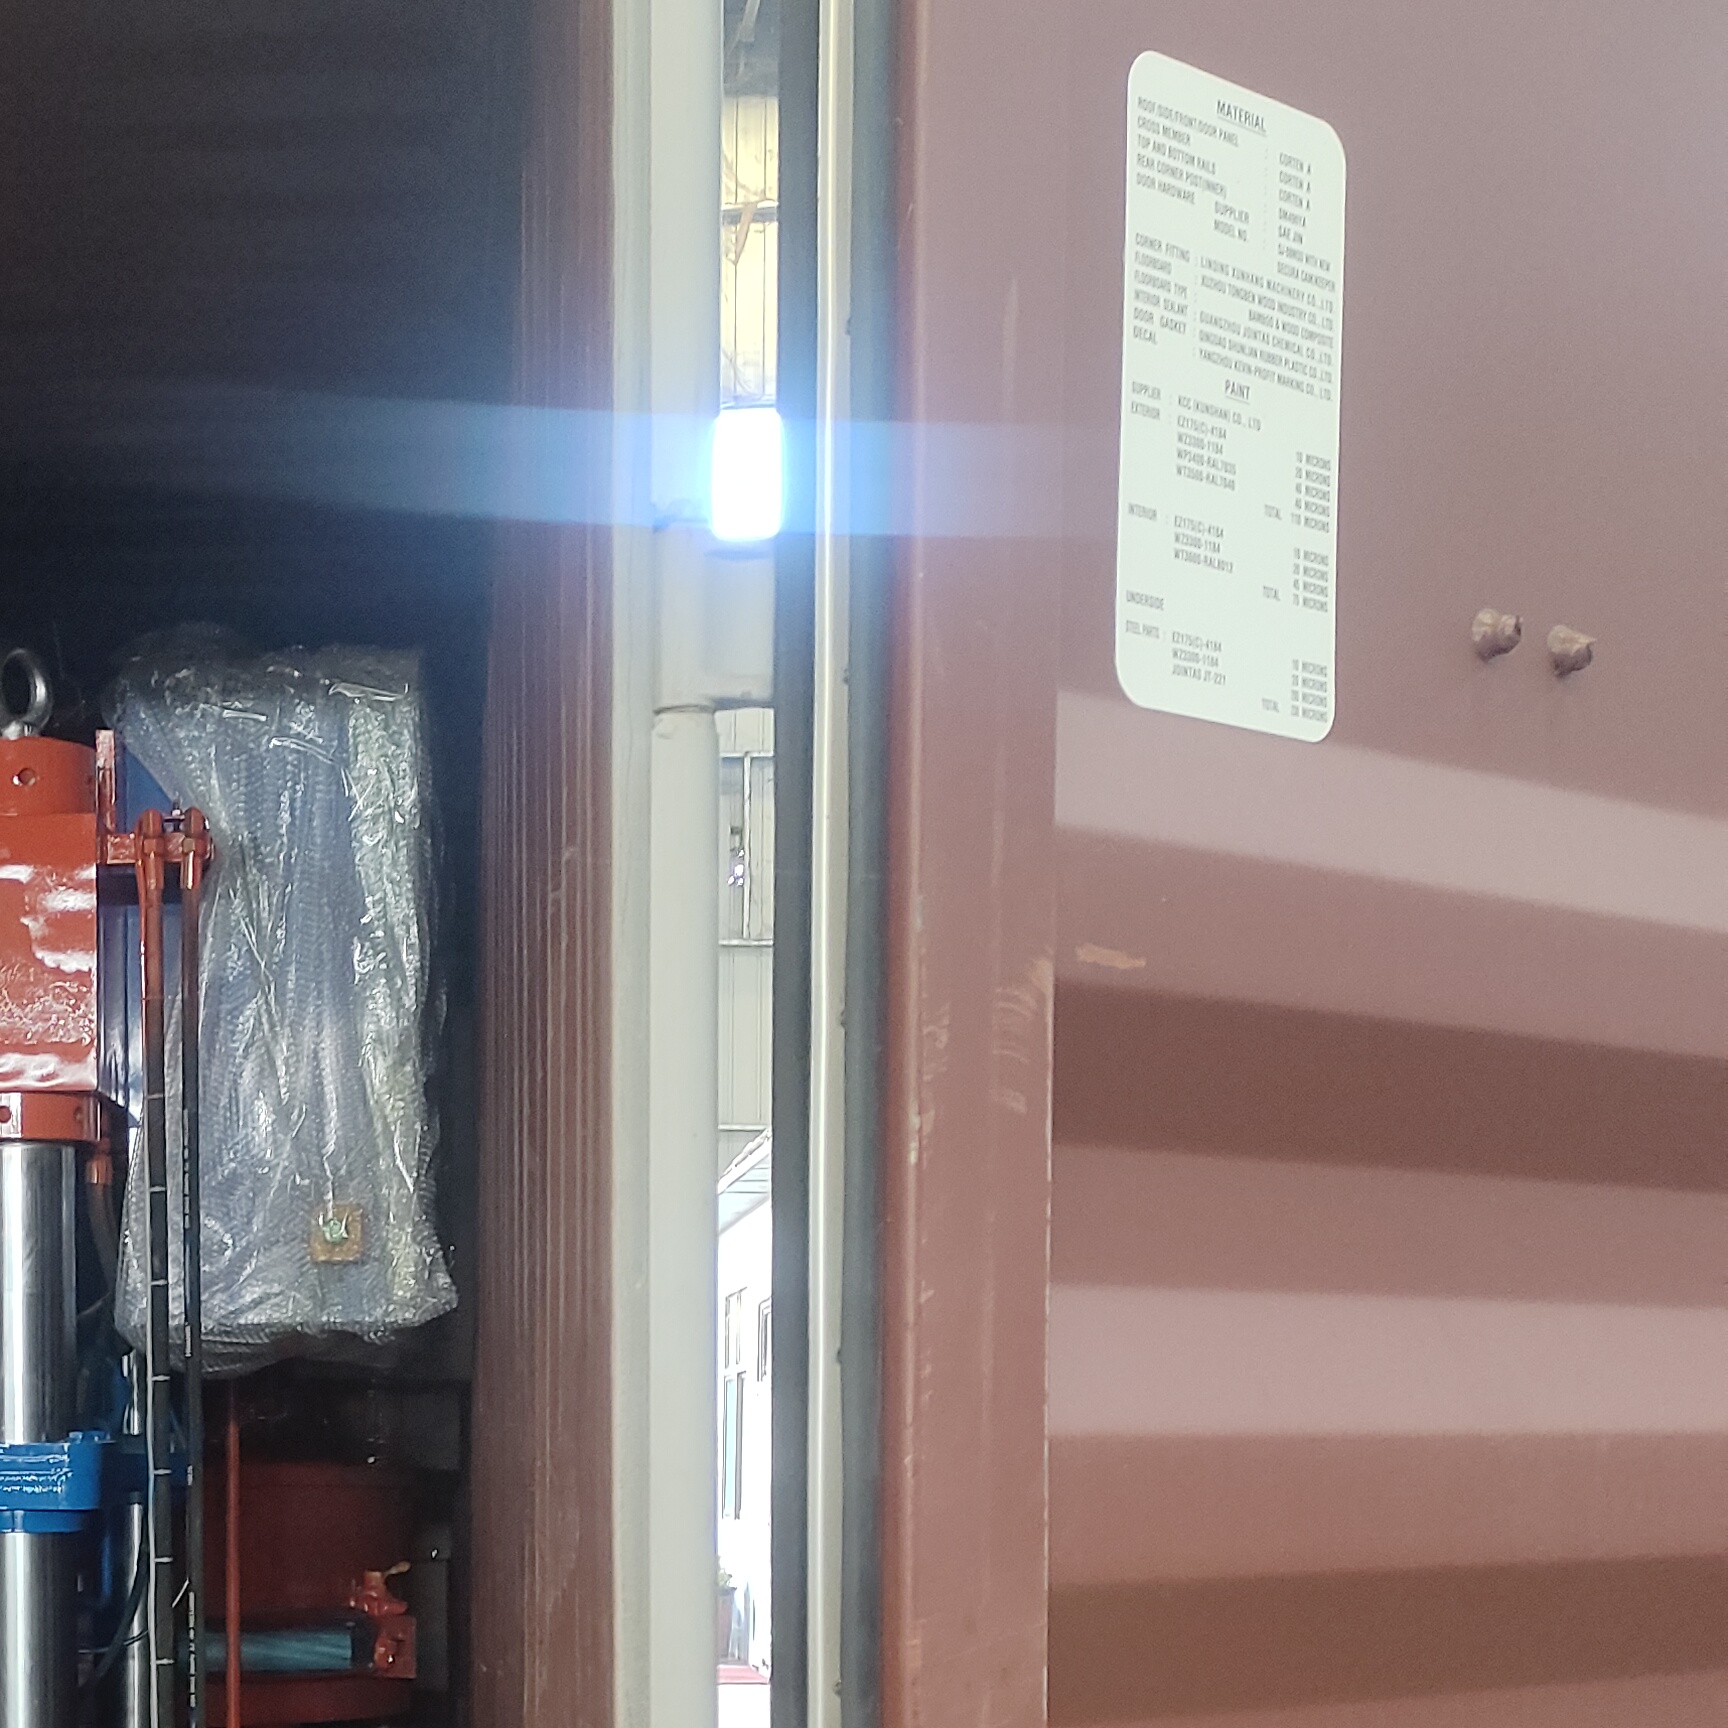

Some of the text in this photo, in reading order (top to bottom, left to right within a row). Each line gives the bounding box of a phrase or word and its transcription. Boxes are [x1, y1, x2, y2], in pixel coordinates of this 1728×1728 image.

[1216, 99, 1266, 132] MATERIAL
[1137, 115, 1160, 136] CROSS
[1162, 124, 1191, 147] MEMBER
[1137, 134, 1151, 149] TOP
[1151, 139, 1167, 157] AND
[1168, 145, 1195, 168] BOTTOM
[1196, 156, 1216, 175] RAILS
[1136, 152, 1155, 171] REAR
[1157, 160, 1184, 181] CORNER
[1136, 172, 1156, 190] DOOR
[1158, 180, 1195, 205] HARDWARE
[1214, 200, 1249, 225] SUPPLIER
[1214, 219, 1235, 238] MODEL
[1135, 232, 1162, 253] CORNER
[1165, 242, 1190, 263] FITTING
[1266, 279, 1305, 303] MACHINERY
[1174, 282, 1188, 300] TYPE
[1133, 307, 1154, 325] DOOR
[1160, 314, 1187, 335] GASKET
[1133, 325, 1157, 345] DECAL
[1272, 335, 1304, 357] CHEMICAL
[1132, 381, 1161, 400] SUPPLIER
[1225, 379, 1250, 400] PAINT
[1130, 400, 1160, 420] EXTERIOR
[1126, 590, 1164, 611] UNDERSIDE
